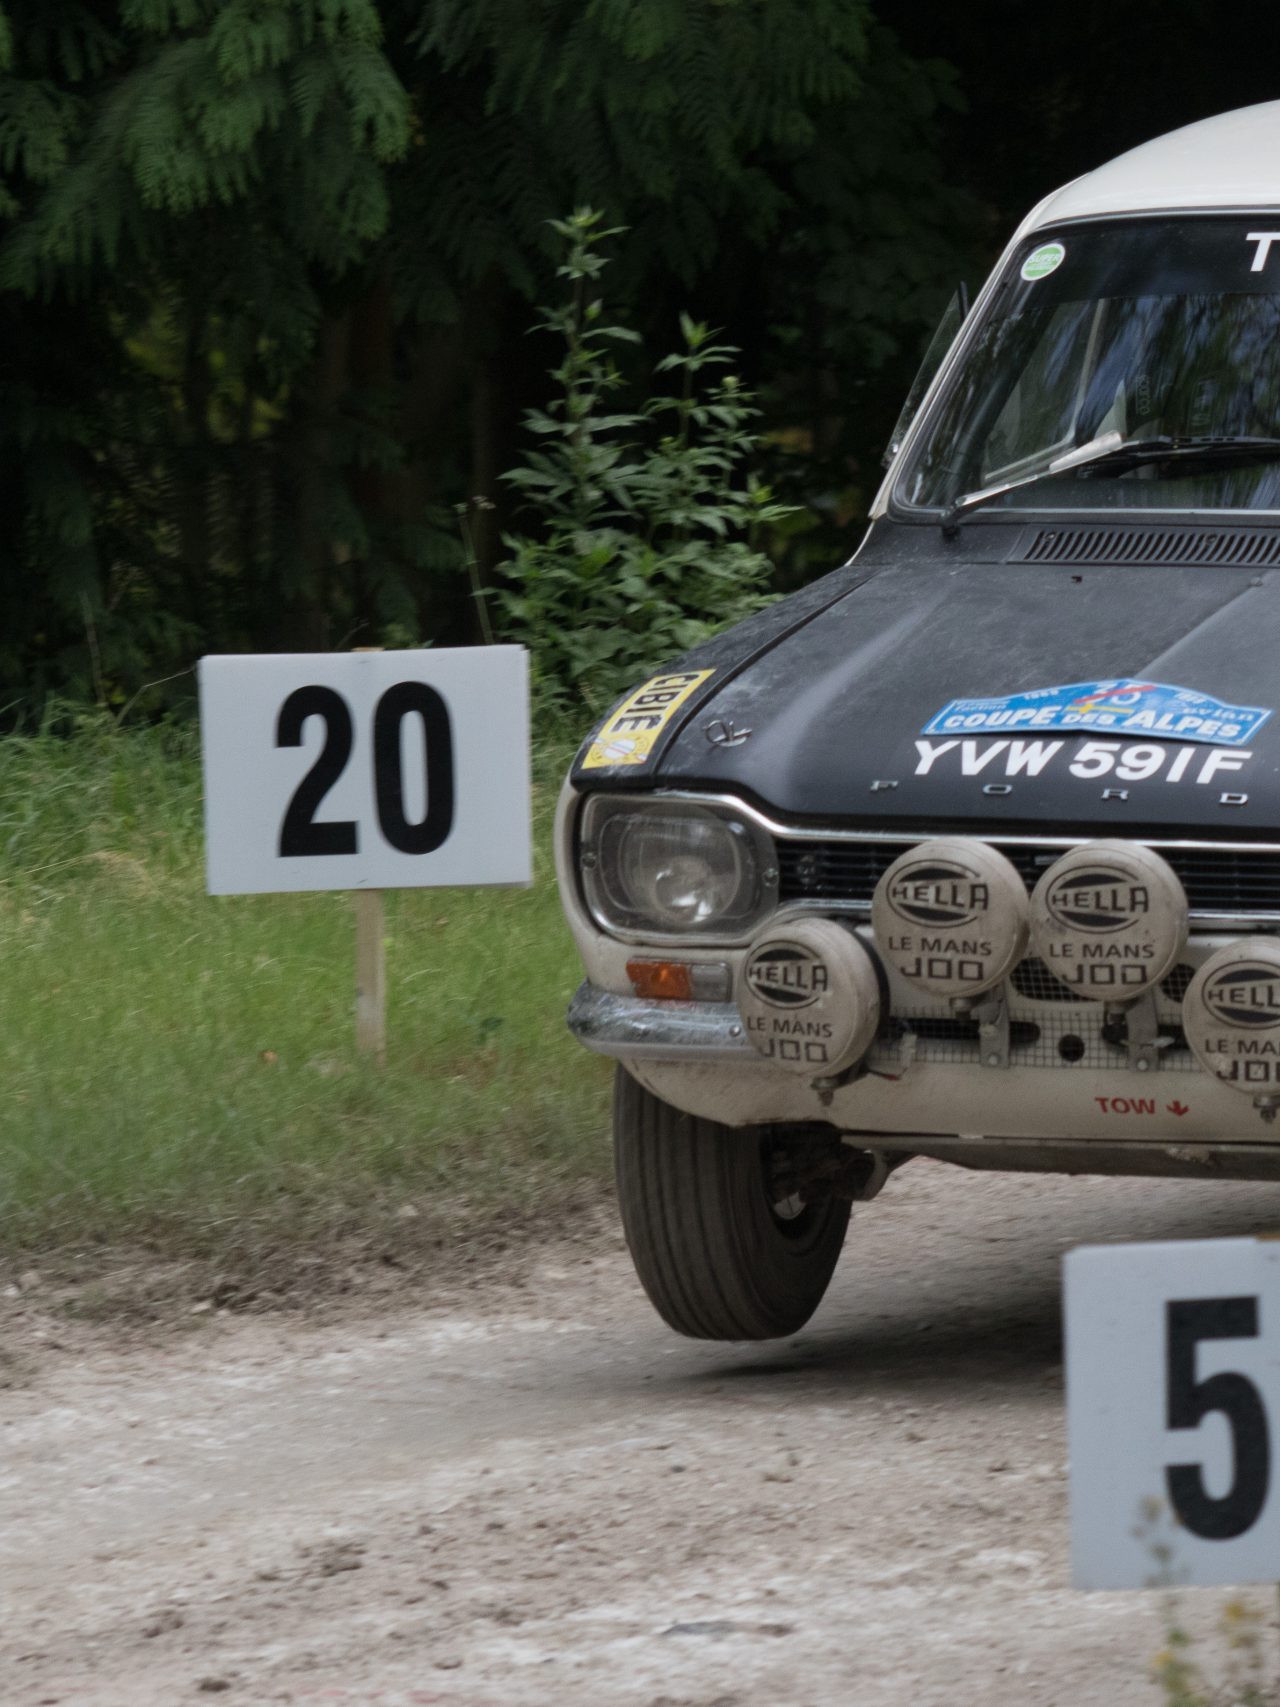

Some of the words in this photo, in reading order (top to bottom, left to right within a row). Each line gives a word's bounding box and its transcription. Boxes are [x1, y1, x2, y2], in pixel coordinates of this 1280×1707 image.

[943, 705, 1062, 728] COUPE
[1061, 713, 1117, 725] DES
[1121, 709, 1241, 737] ALPES
[276, 680, 456, 858] 20
[914, 740, 1064, 776] YVW
[1068, 743, 1252, 784] 591F
[870, 780, 1249, 805] FORD
[892, 882, 989, 911] HELLA
[1051, 886, 1149, 912] HELLA
[888, 936, 911, 951] LE
[921, 937, 992, 956] MANS
[1049, 943, 1073, 957] LE
[1082, 944, 1155, 959] MANS
[749, 964, 828, 992] HELLA
[747, 1016, 767, 1031] LE
[773, 1018, 833, 1037] MANS
[1205, 1039, 1228, 1053] LE
[1095, 1096, 1156, 1114] TOW
